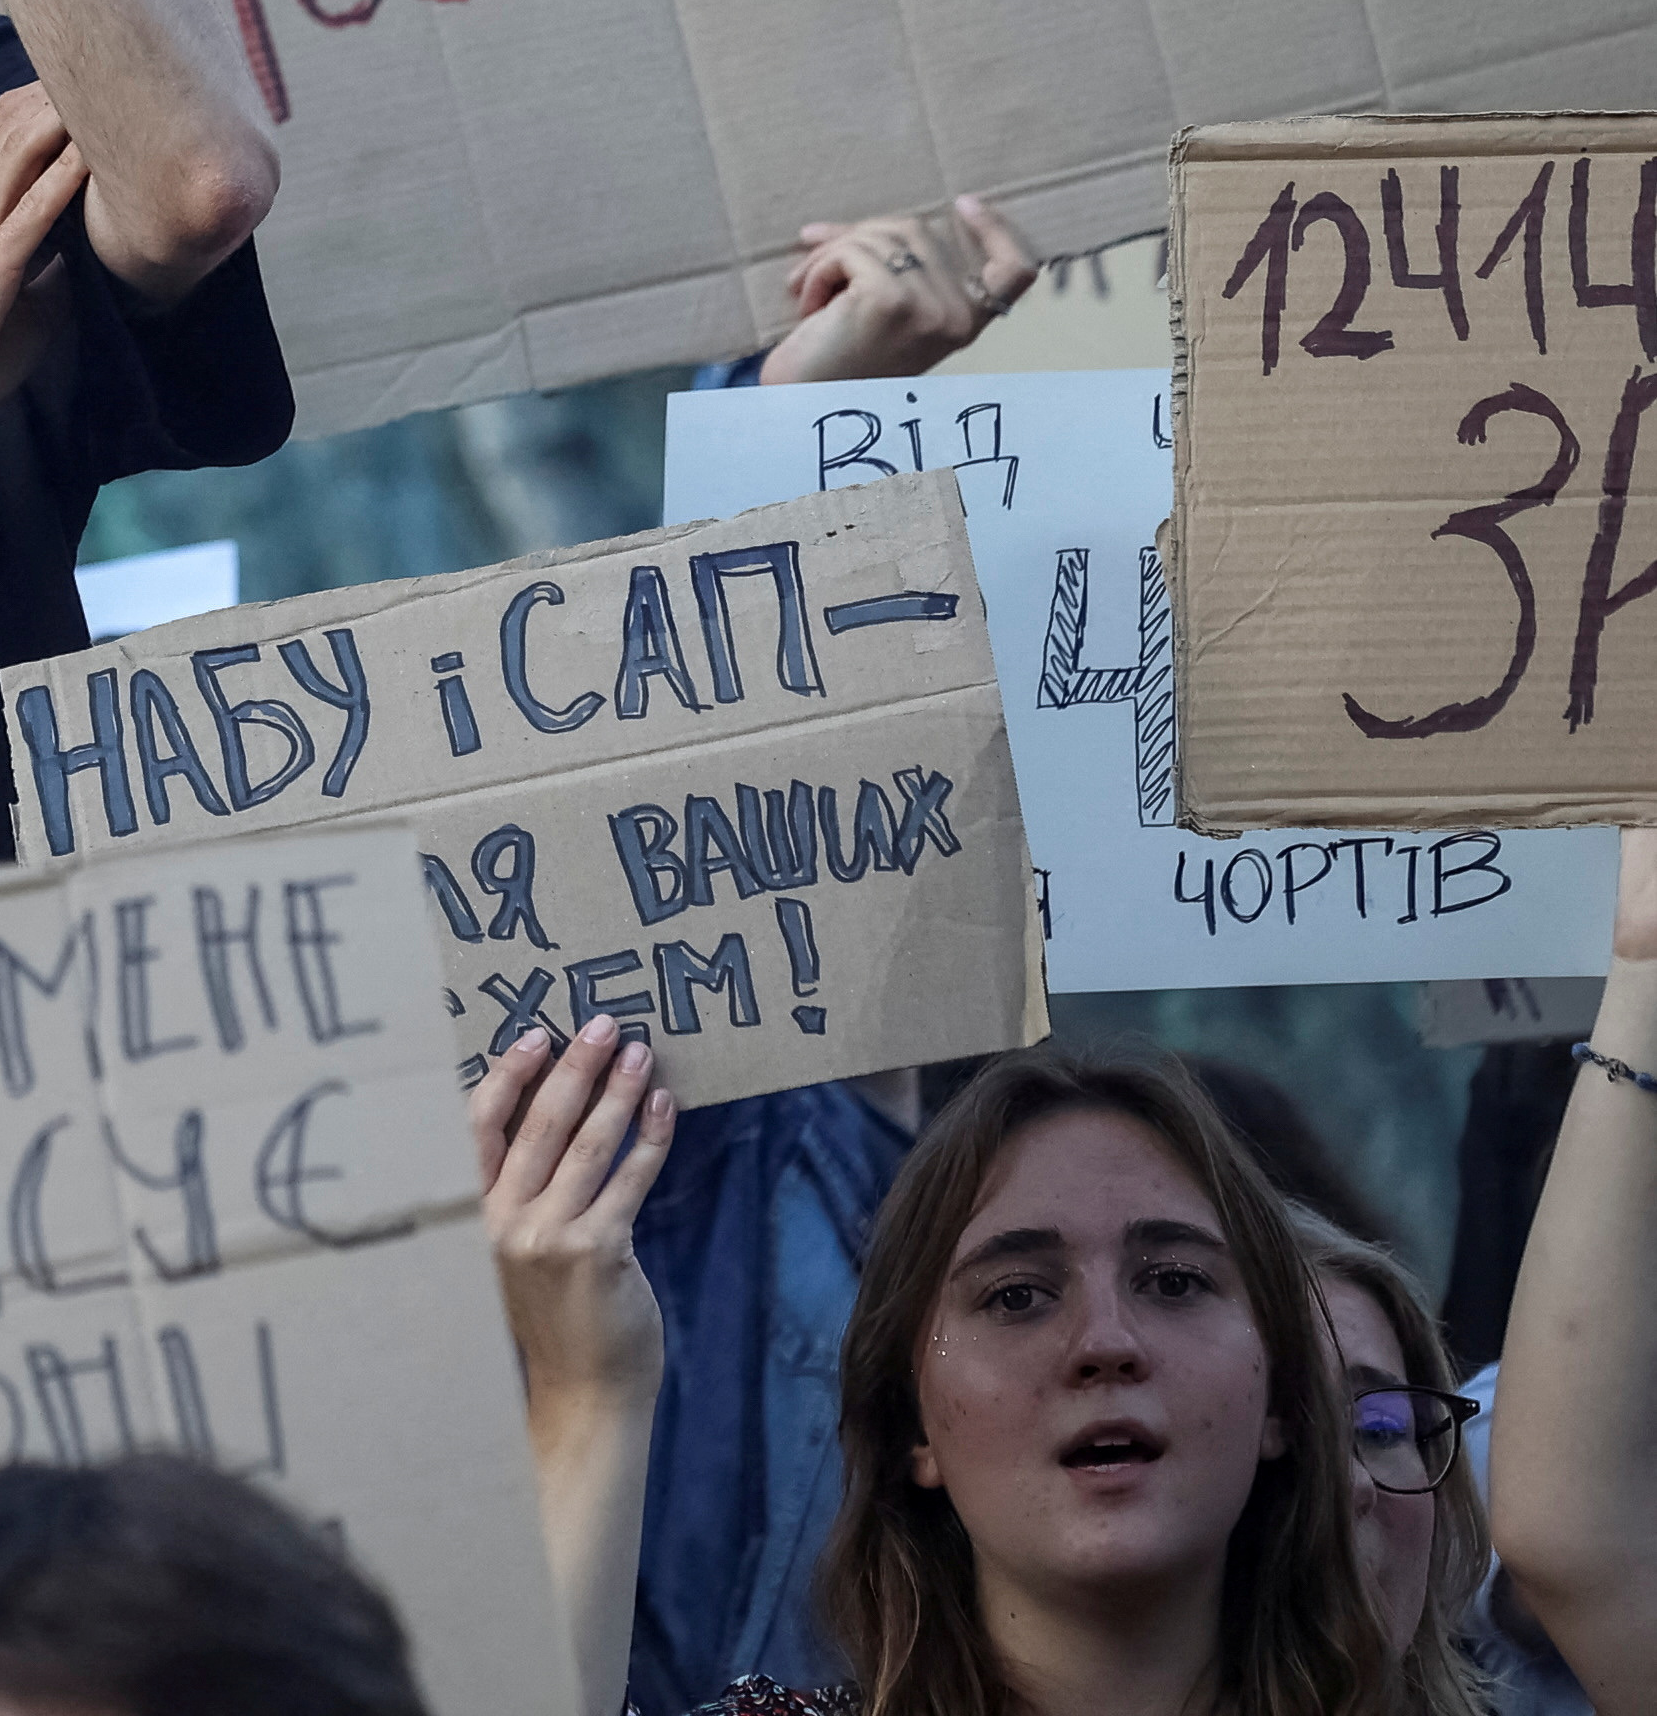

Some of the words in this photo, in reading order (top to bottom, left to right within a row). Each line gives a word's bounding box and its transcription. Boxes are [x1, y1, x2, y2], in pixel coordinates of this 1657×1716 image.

[1221, 156, 1657, 376] 12414
[17, 628, 370, 858] НАБУ
[429, 650, 483, 758] і
[608, 765, 961, 927] ВАШИХ
[1172, 830, 1513, 937] ЧОРТІВ
